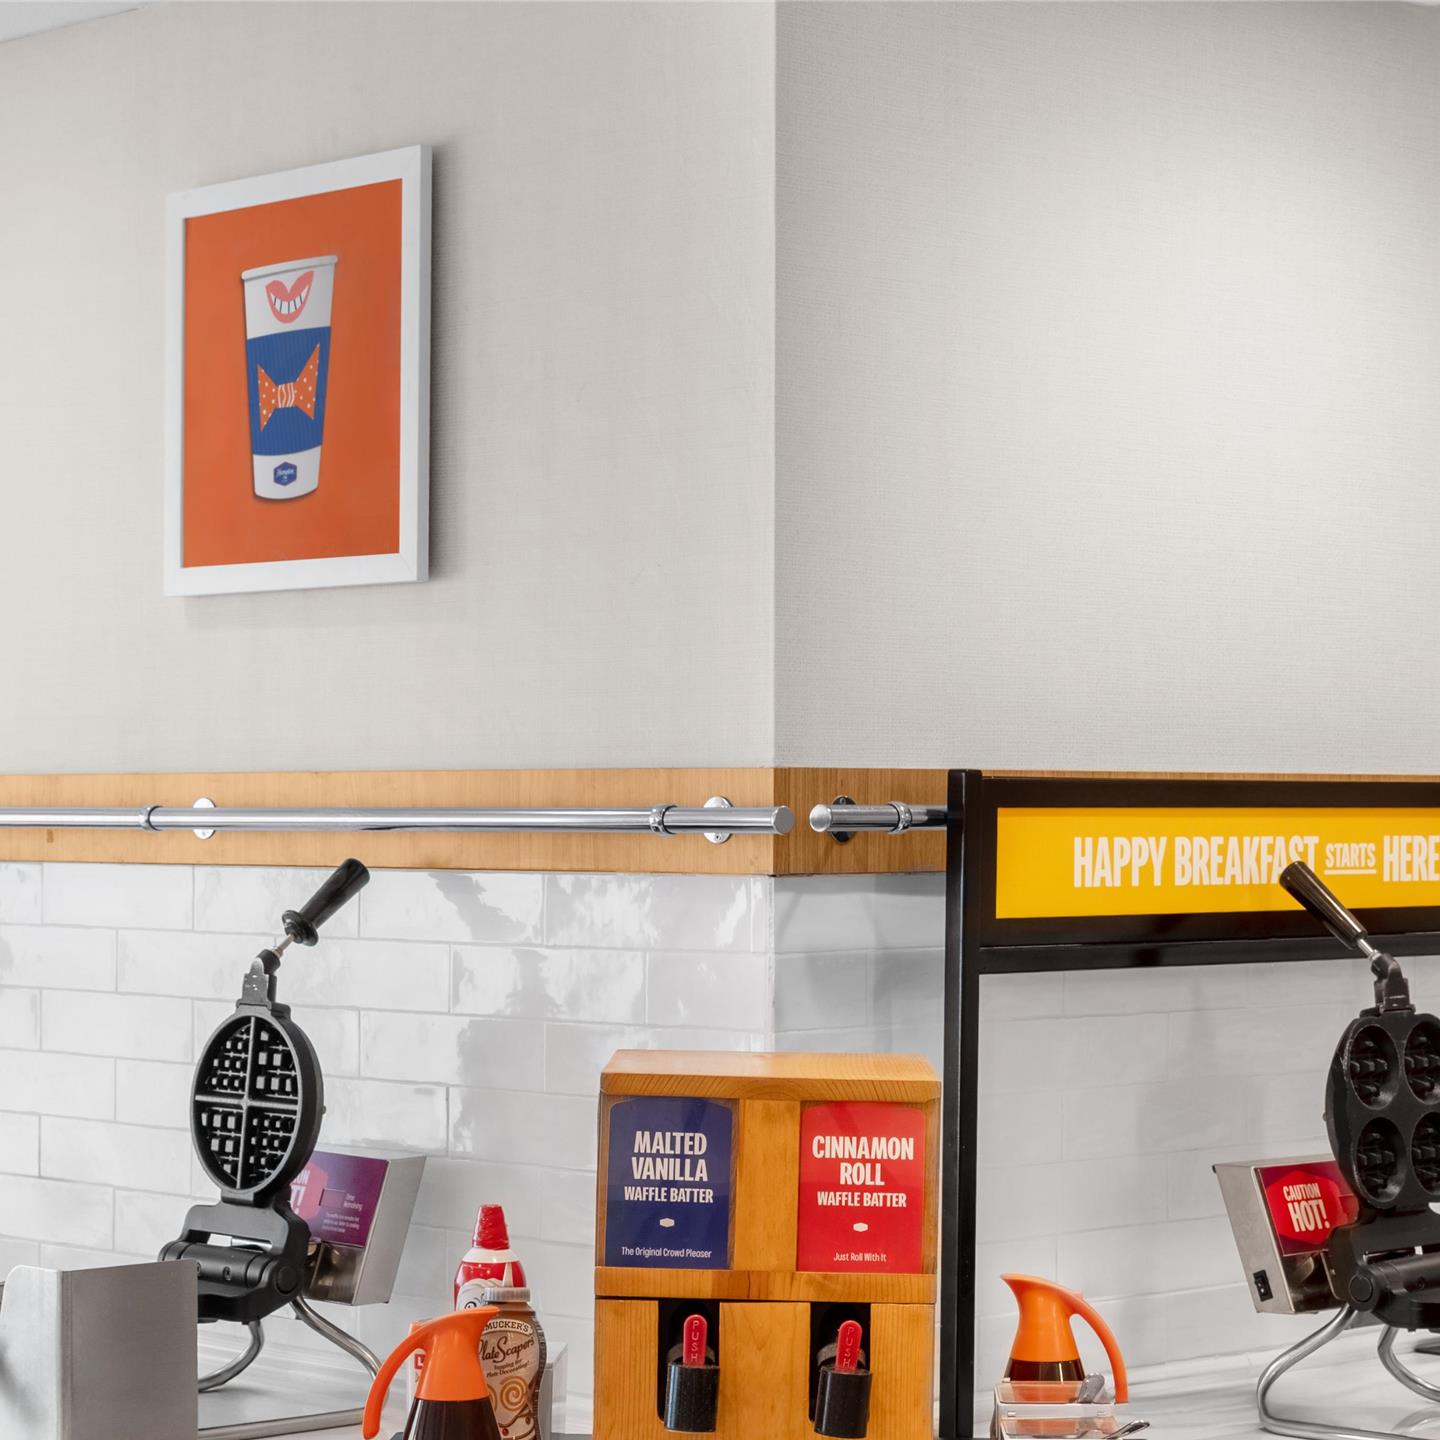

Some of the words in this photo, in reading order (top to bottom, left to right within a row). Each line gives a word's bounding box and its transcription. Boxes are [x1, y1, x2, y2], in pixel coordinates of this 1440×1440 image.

[1074, 835, 1167, 887] HAPPY
[1174, 835, 1320, 886] BREAKFAST
[1325, 842, 1376, 868] STARTS
[1382, 834, 1440, 882] HERE
[633, 1130, 707, 1156] MALTED
[812, 1134, 915, 1161] CINNAMON
[631, 1156, 709, 1182] VANILLA
[839, 1162, 885, 1186] ROLL
[624, 1185, 668, 1203] WAFFLE
[669, 1187, 714, 1204] BATTER
[816, 1190, 860, 1207] WAFFLE
[862, 1192, 907, 1208] BATTER
[1282, 1183, 1321, 1202] CAUTION
[1287, 1199, 1331, 1233] HOT!
[621, 1246, 634, 1257] The
[635, 1246, 663, 1259] Original
[663, 1247, 685, 1258] Crowd
[686, 1248, 712, 1259] Pleaser
[833, 1252, 849, 1262] Just
[851, 1252, 863, 1262] Roll
[864, 1252, 879, 1263] With
[880, 1253, 887, 1263] It
[485, 1320, 530, 1333] MUCKER'S
[691, 1320, 700, 1362] PUSH
[842, 1326, 856, 1368] PUSH
